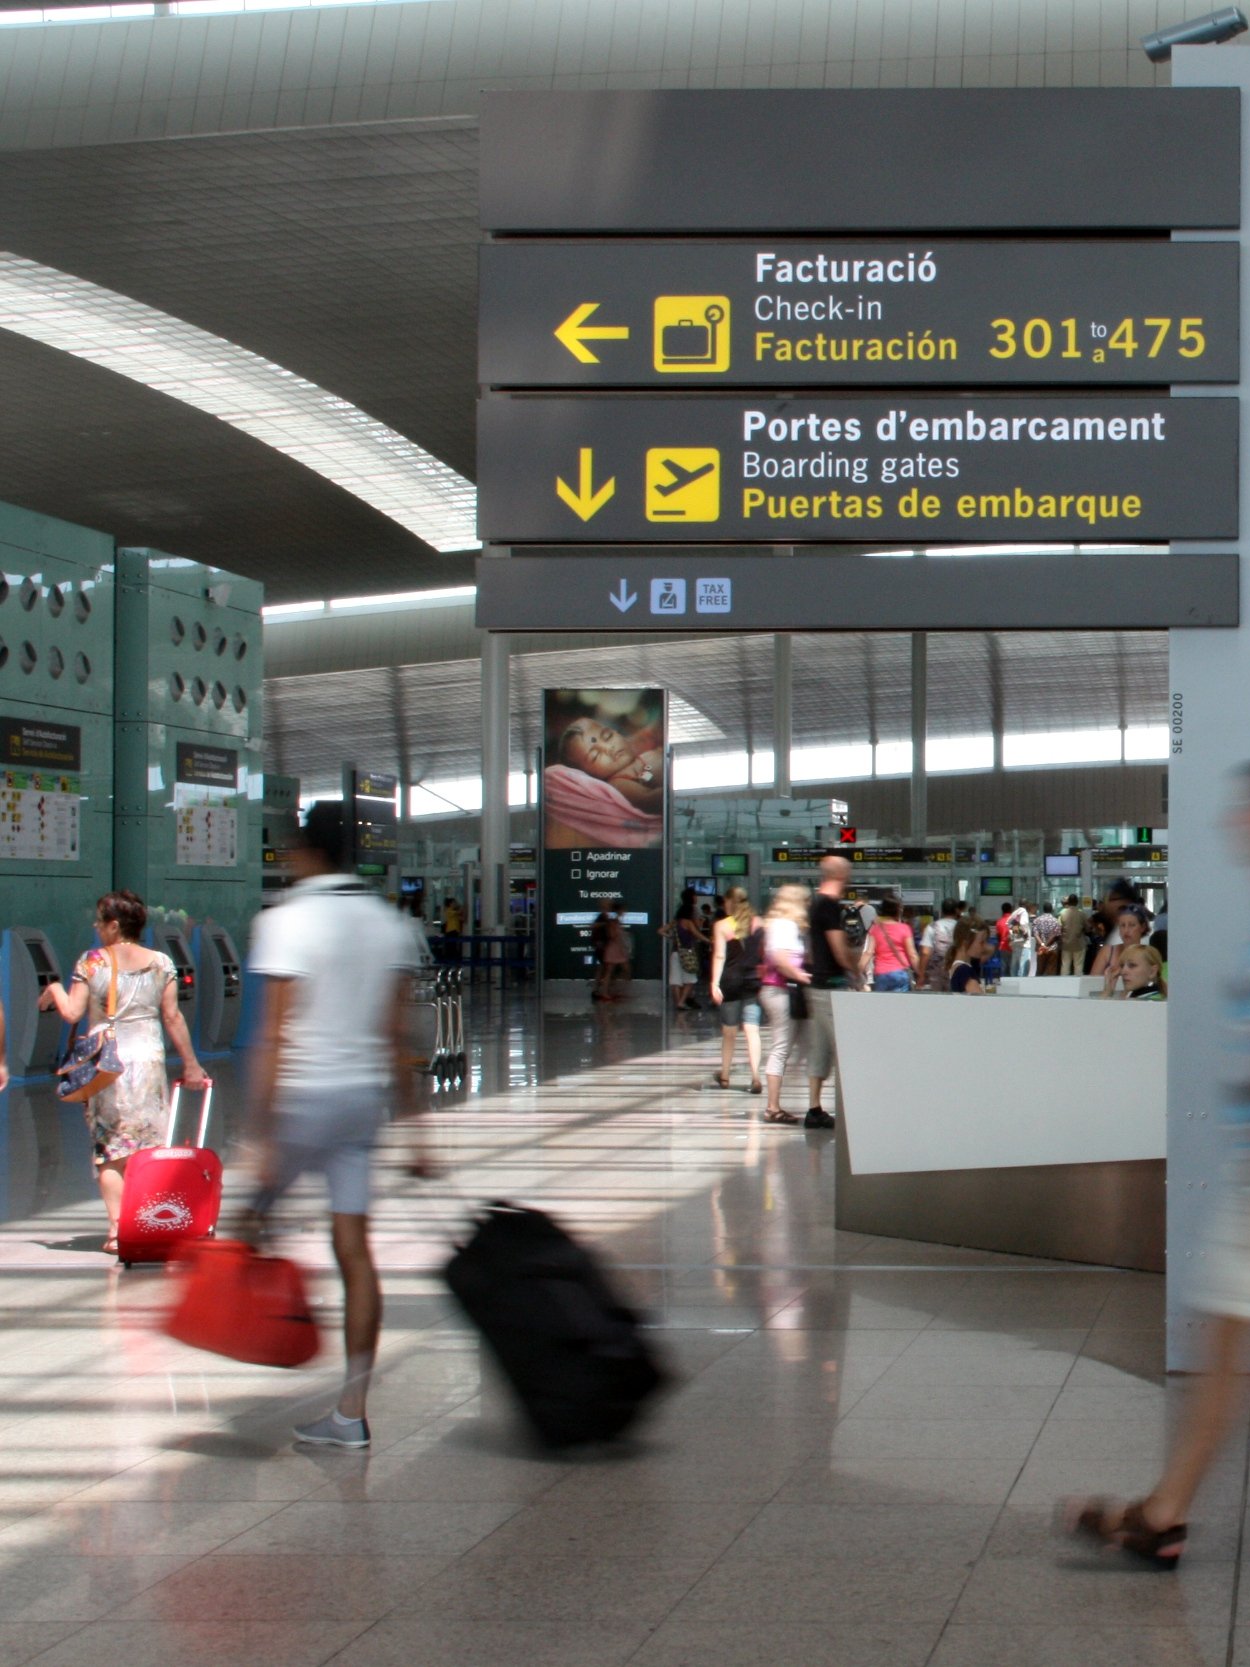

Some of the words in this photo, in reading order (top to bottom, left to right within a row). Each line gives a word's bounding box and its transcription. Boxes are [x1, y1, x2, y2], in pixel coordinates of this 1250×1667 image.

[755, 252, 936, 282] Facturació
[755, 294, 882, 320] Check-in
[989, 318, 1082, 358] 301
[1090, 322, 1107, 338] to
[1109, 318, 1206, 358] 475
[755, 331, 957, 360] Facturación
[1093, 348, 1105, 363] a
[743, 410, 861, 442] Portes
[876, 410, 1166, 442] d'embarcament
[743, 452, 869, 484] Boarding
[881, 455, 960, 484] gates
[743, 488, 883, 518] Puertas
[898, 488, 941, 518] de
[956, 488, 1141, 525] embarque
[698, 595, 728, 606] FREE
[702, 584, 725, 594] TAX
[1172, 693, 1183, 734] 00200
[1172, 739, 1183, 754] SE
[586, 851, 632, 862] Apadrinar
[586, 869, 619, 880] Ignorar
[590, 890, 624, 899] escoges.
